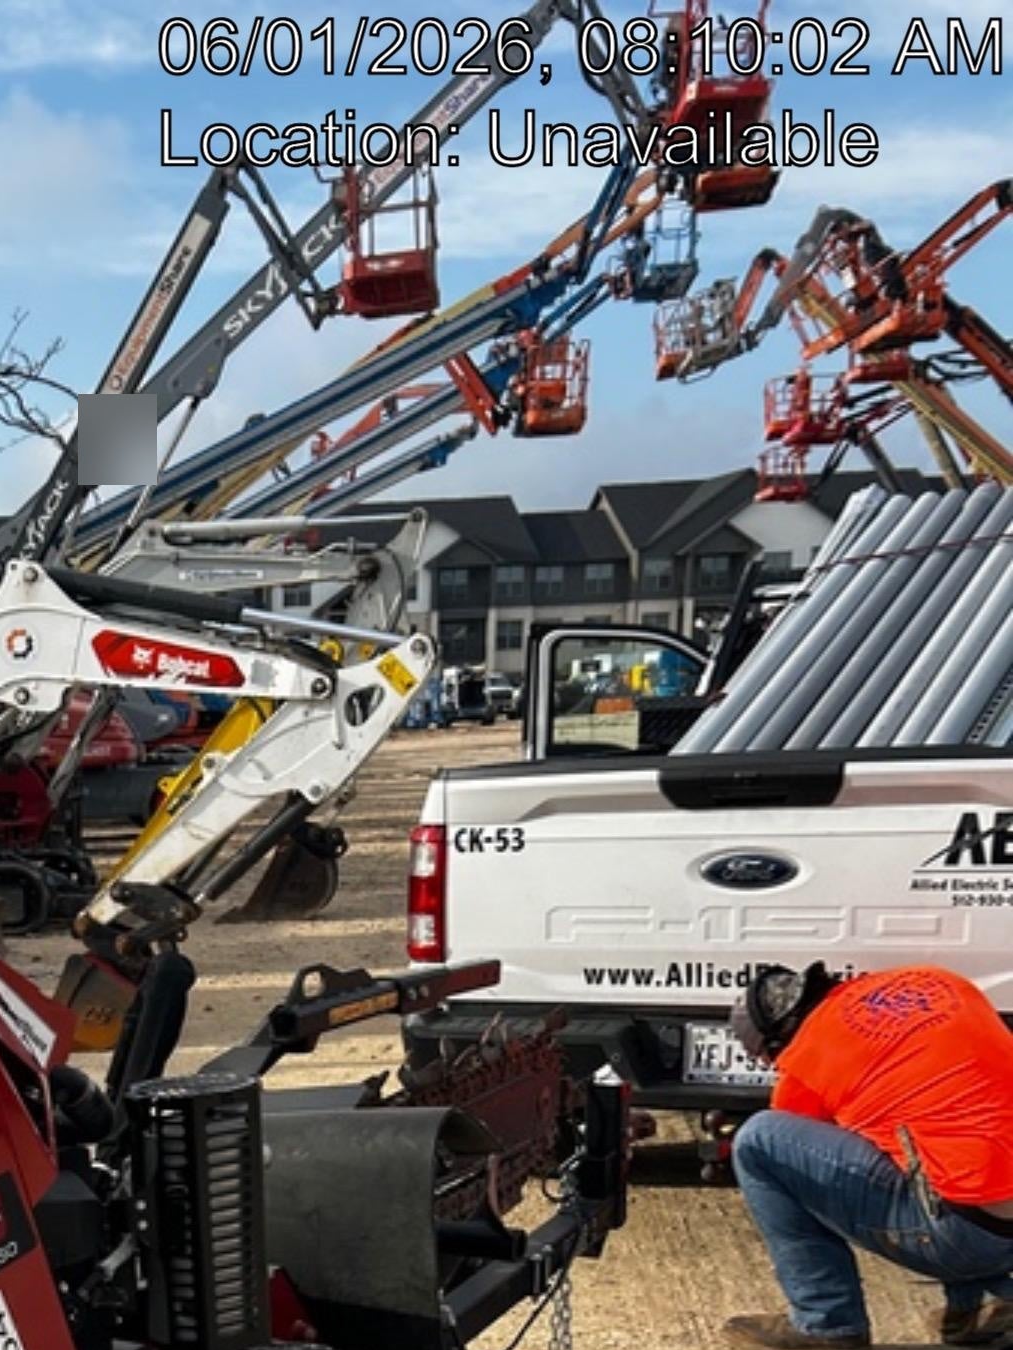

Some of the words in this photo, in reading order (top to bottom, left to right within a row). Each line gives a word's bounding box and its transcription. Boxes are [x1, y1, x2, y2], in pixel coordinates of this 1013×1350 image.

[223, 214, 345, 338] SKYJCK
[453, 827, 526, 853] CK-53
[911, 878, 949, 892] Allied
[951, 878, 999, 892] Electric
[544, 904, 972, 947] F-150
